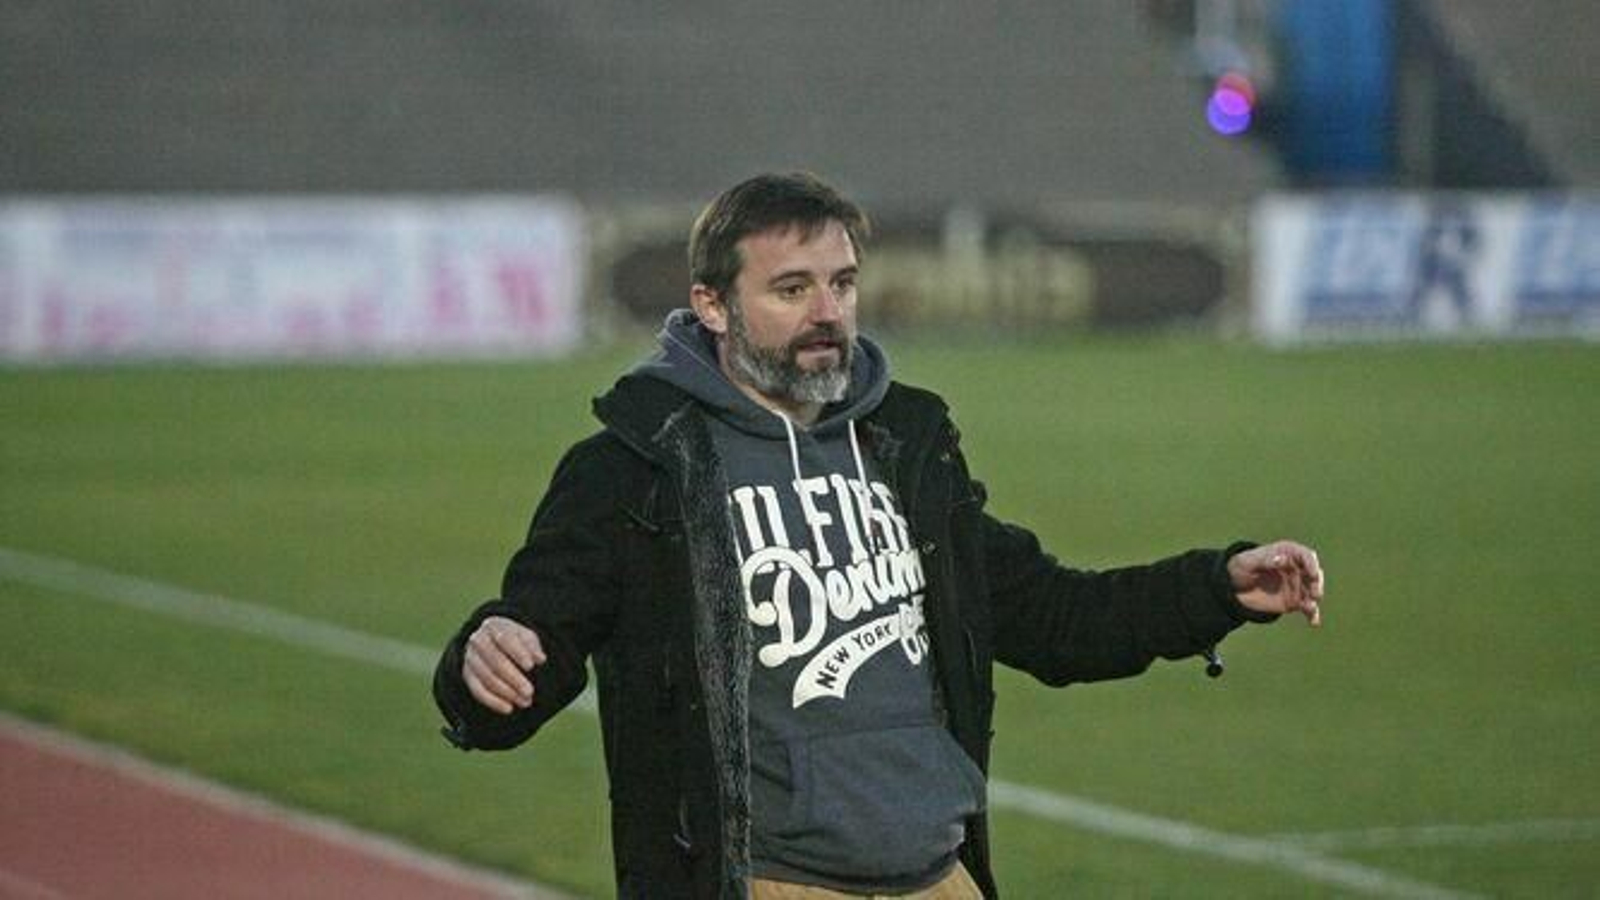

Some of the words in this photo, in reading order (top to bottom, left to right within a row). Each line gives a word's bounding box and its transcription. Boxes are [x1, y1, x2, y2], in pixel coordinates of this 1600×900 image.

[741, 546, 926, 667] Denim
[815, 647, 850, 690] NEW
[851, 623, 892, 651] YORK
